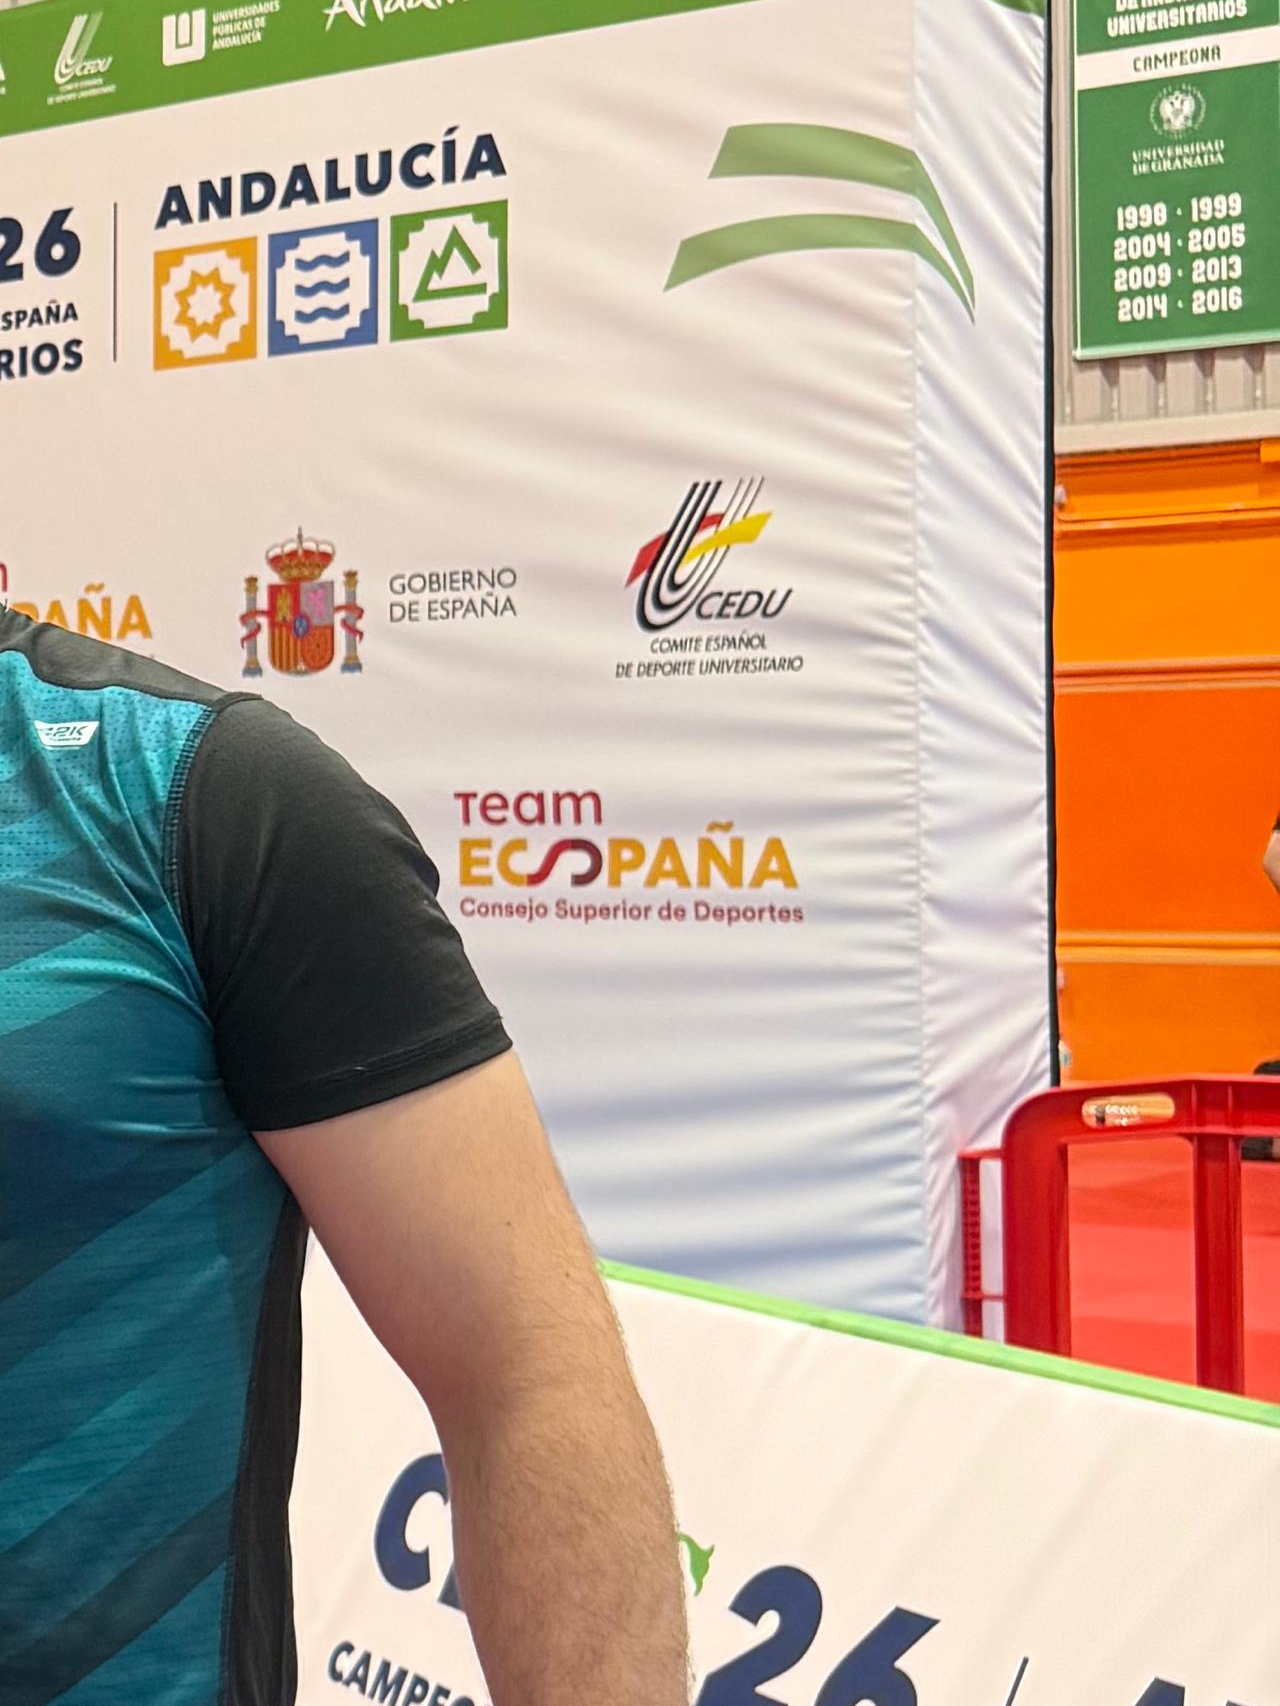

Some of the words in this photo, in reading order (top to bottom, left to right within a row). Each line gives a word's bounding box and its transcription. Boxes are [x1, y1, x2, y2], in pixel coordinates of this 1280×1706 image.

[212, 0, 281, 25] UNIVERSIDADES
[212, 18, 253, 38] PÚBLICAS
[254, 15, 267, 29] DE
[1133, 44, 1222, 73] CAMPEONA
[1132, 138, 1225, 164] UNIVERSIDAD
[1151, 152, 1225, 173] GRANADA
[154, 126, 508, 230] ANDALUCÍA
[1116, 201, 1168, 231] 1998
[1190, 191, 1242, 223] 1999
[1113, 231, 1171, 262] 2004
[1188, 222, 1246, 254] 2005
[1114, 262, 1172, 293] 2009
[1191, 254, 1242, 284] 2013
[1118, 292, 1168, 322] 2014
[1191, 285, 1243, 314] 2016
[389, 567, 518, 595] GOBIERNO
[389, 601, 420, 623] DE
[427, 591, 518, 621] ESPAÑA
[695, 588, 793, 620] CEDU
[705, 629, 768, 653] ESPAÑOL
[615, 660, 633, 679] DE
[637, 658, 696, 678] DEPORTE
[699, 654, 805, 676] UNIVERSITARIO
[459, 896, 548, 923] Consejo
[554, 898, 652, 924] Superior
[657, 899, 686, 922] de
[694, 899, 804, 926] Deportes
